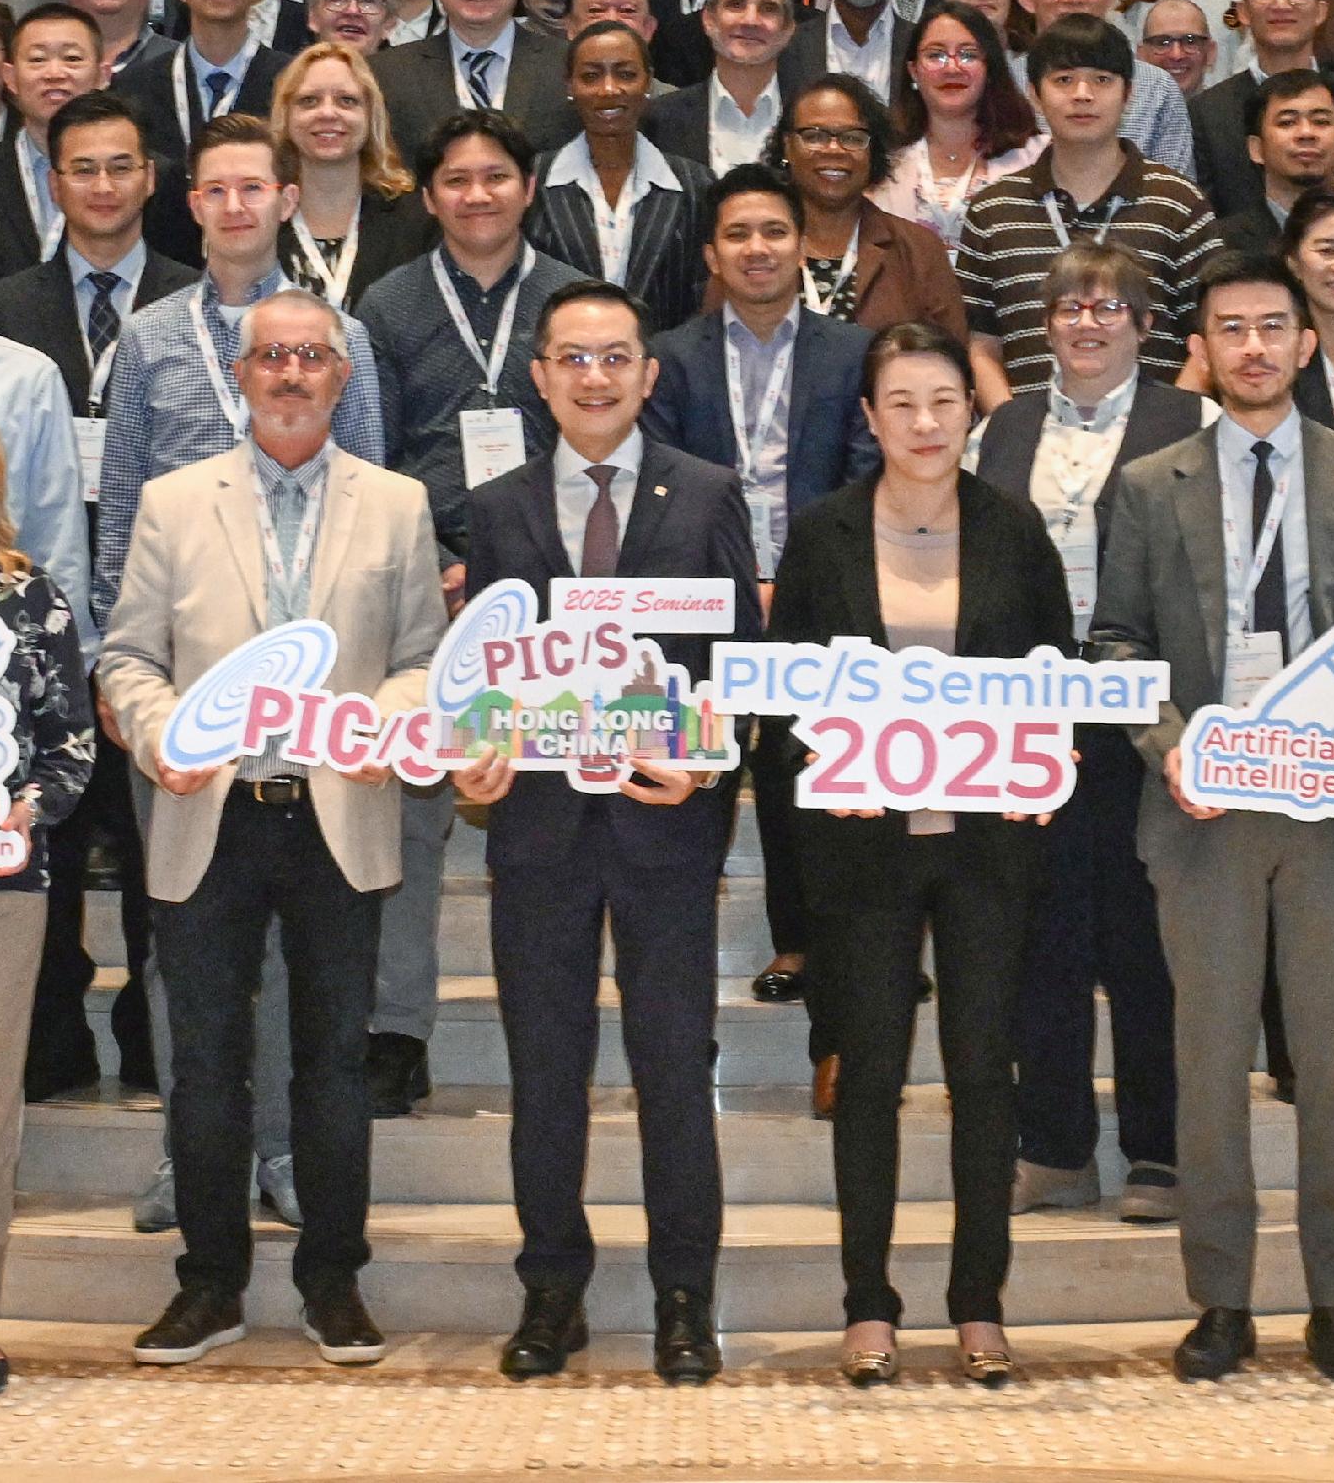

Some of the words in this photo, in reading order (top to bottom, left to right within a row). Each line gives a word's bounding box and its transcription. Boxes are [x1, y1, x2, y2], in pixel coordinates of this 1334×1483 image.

[563, 589, 625, 611] 2025
[631, 590, 726, 613] Seminar
[483, 622, 628, 685] PIC/S
[722, 651, 881, 707] PIC/S
[902, 659, 1159, 709] Seminar
[492, 709, 579, 731] HONG
[591, 710, 674, 731] KONG
[536, 733, 630, 756] CHINA
[809, 716, 1064, 800] 2025
